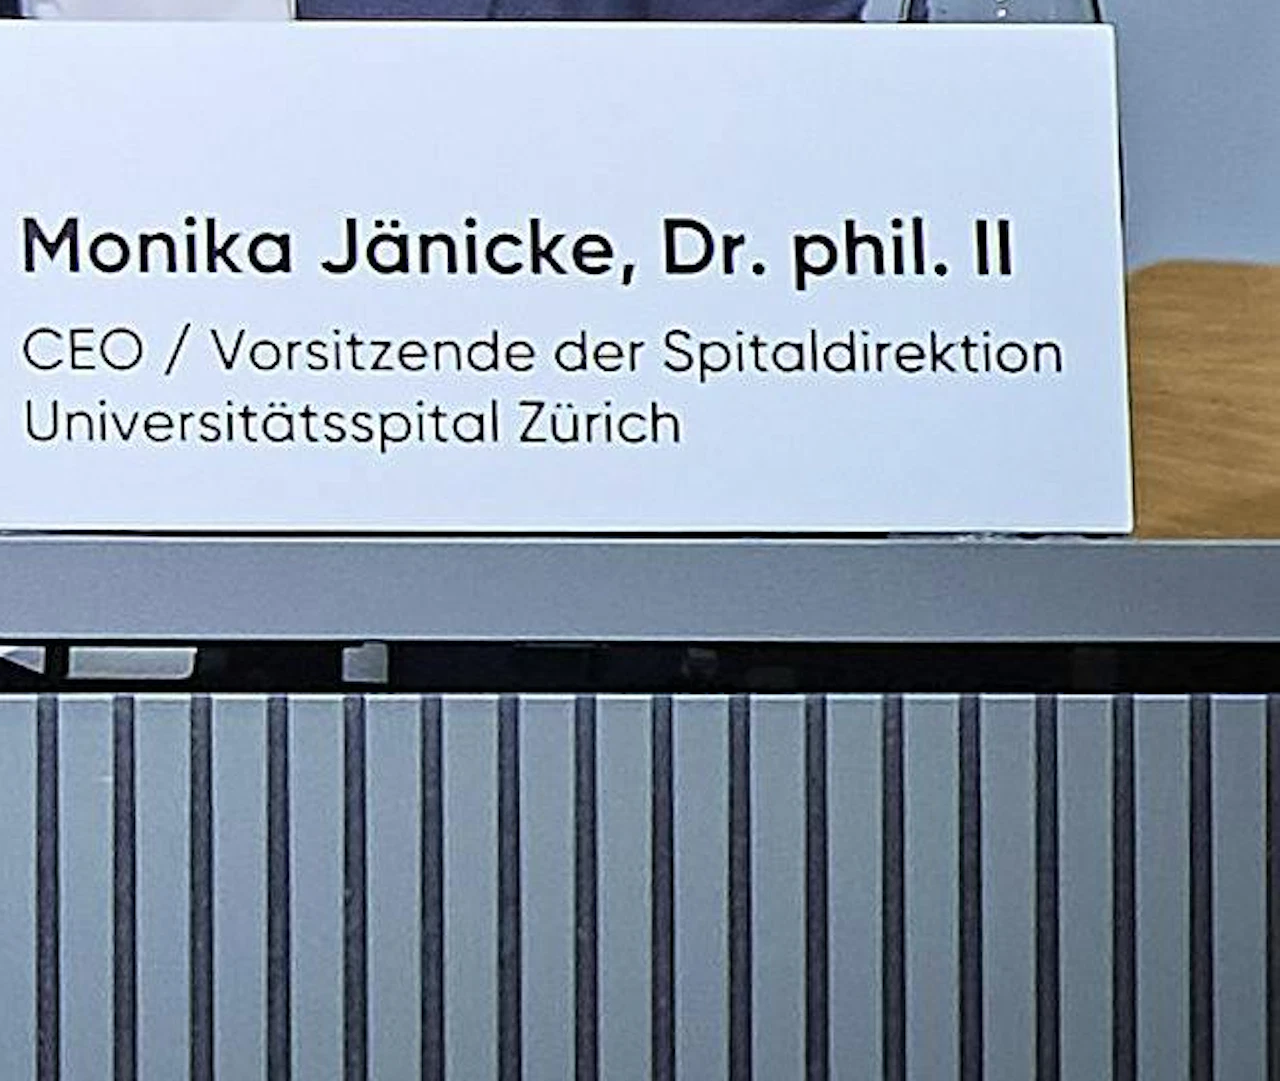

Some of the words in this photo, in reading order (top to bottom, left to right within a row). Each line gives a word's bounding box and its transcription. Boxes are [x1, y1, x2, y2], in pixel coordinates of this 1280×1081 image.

[23, 215, 292, 274] Monika
[321, 216, 635, 287] Jänicke,
[663, 218, 766, 276] Dr.
[793, 216, 948, 292] phil.
[975, 218, 1012, 276] II
[22, 327, 143, 371] CEO
[164, 322, 191, 376] /
[210, 326, 536, 372] Vorsitzende
[554, 327, 645, 372] der
[663, 326, 1062, 384] Spitaldirektion
[25, 397, 498, 453] Universitätsspital
[518, 399, 680, 444] Zürich
